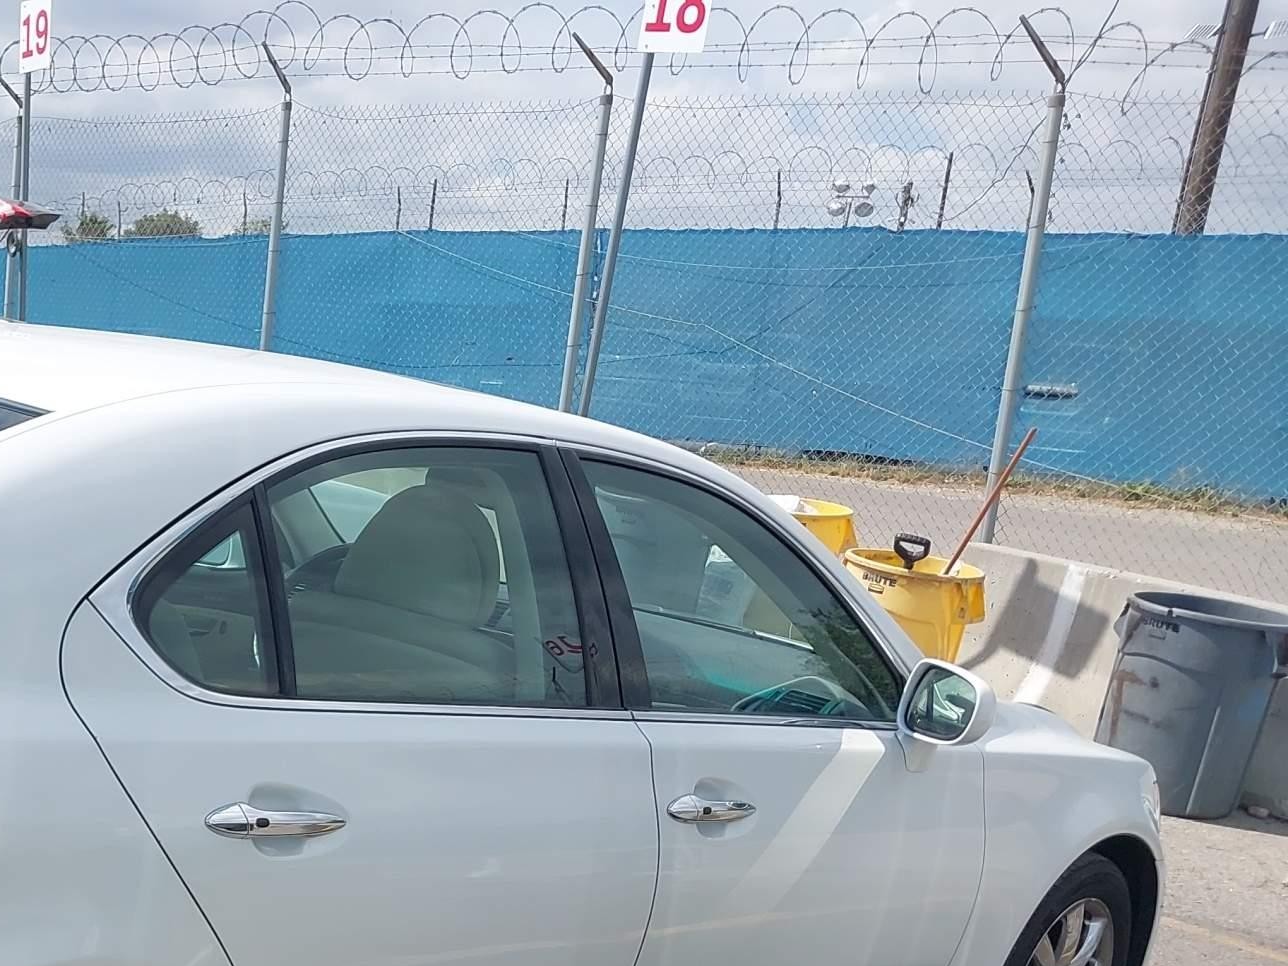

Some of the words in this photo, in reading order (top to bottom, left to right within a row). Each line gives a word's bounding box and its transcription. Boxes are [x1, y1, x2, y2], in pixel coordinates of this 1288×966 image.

[22, 9, 49, 59] 19
[862, 571, 897, 588] BRUTE
[1143, 616, 1180, 634] BRUTE
